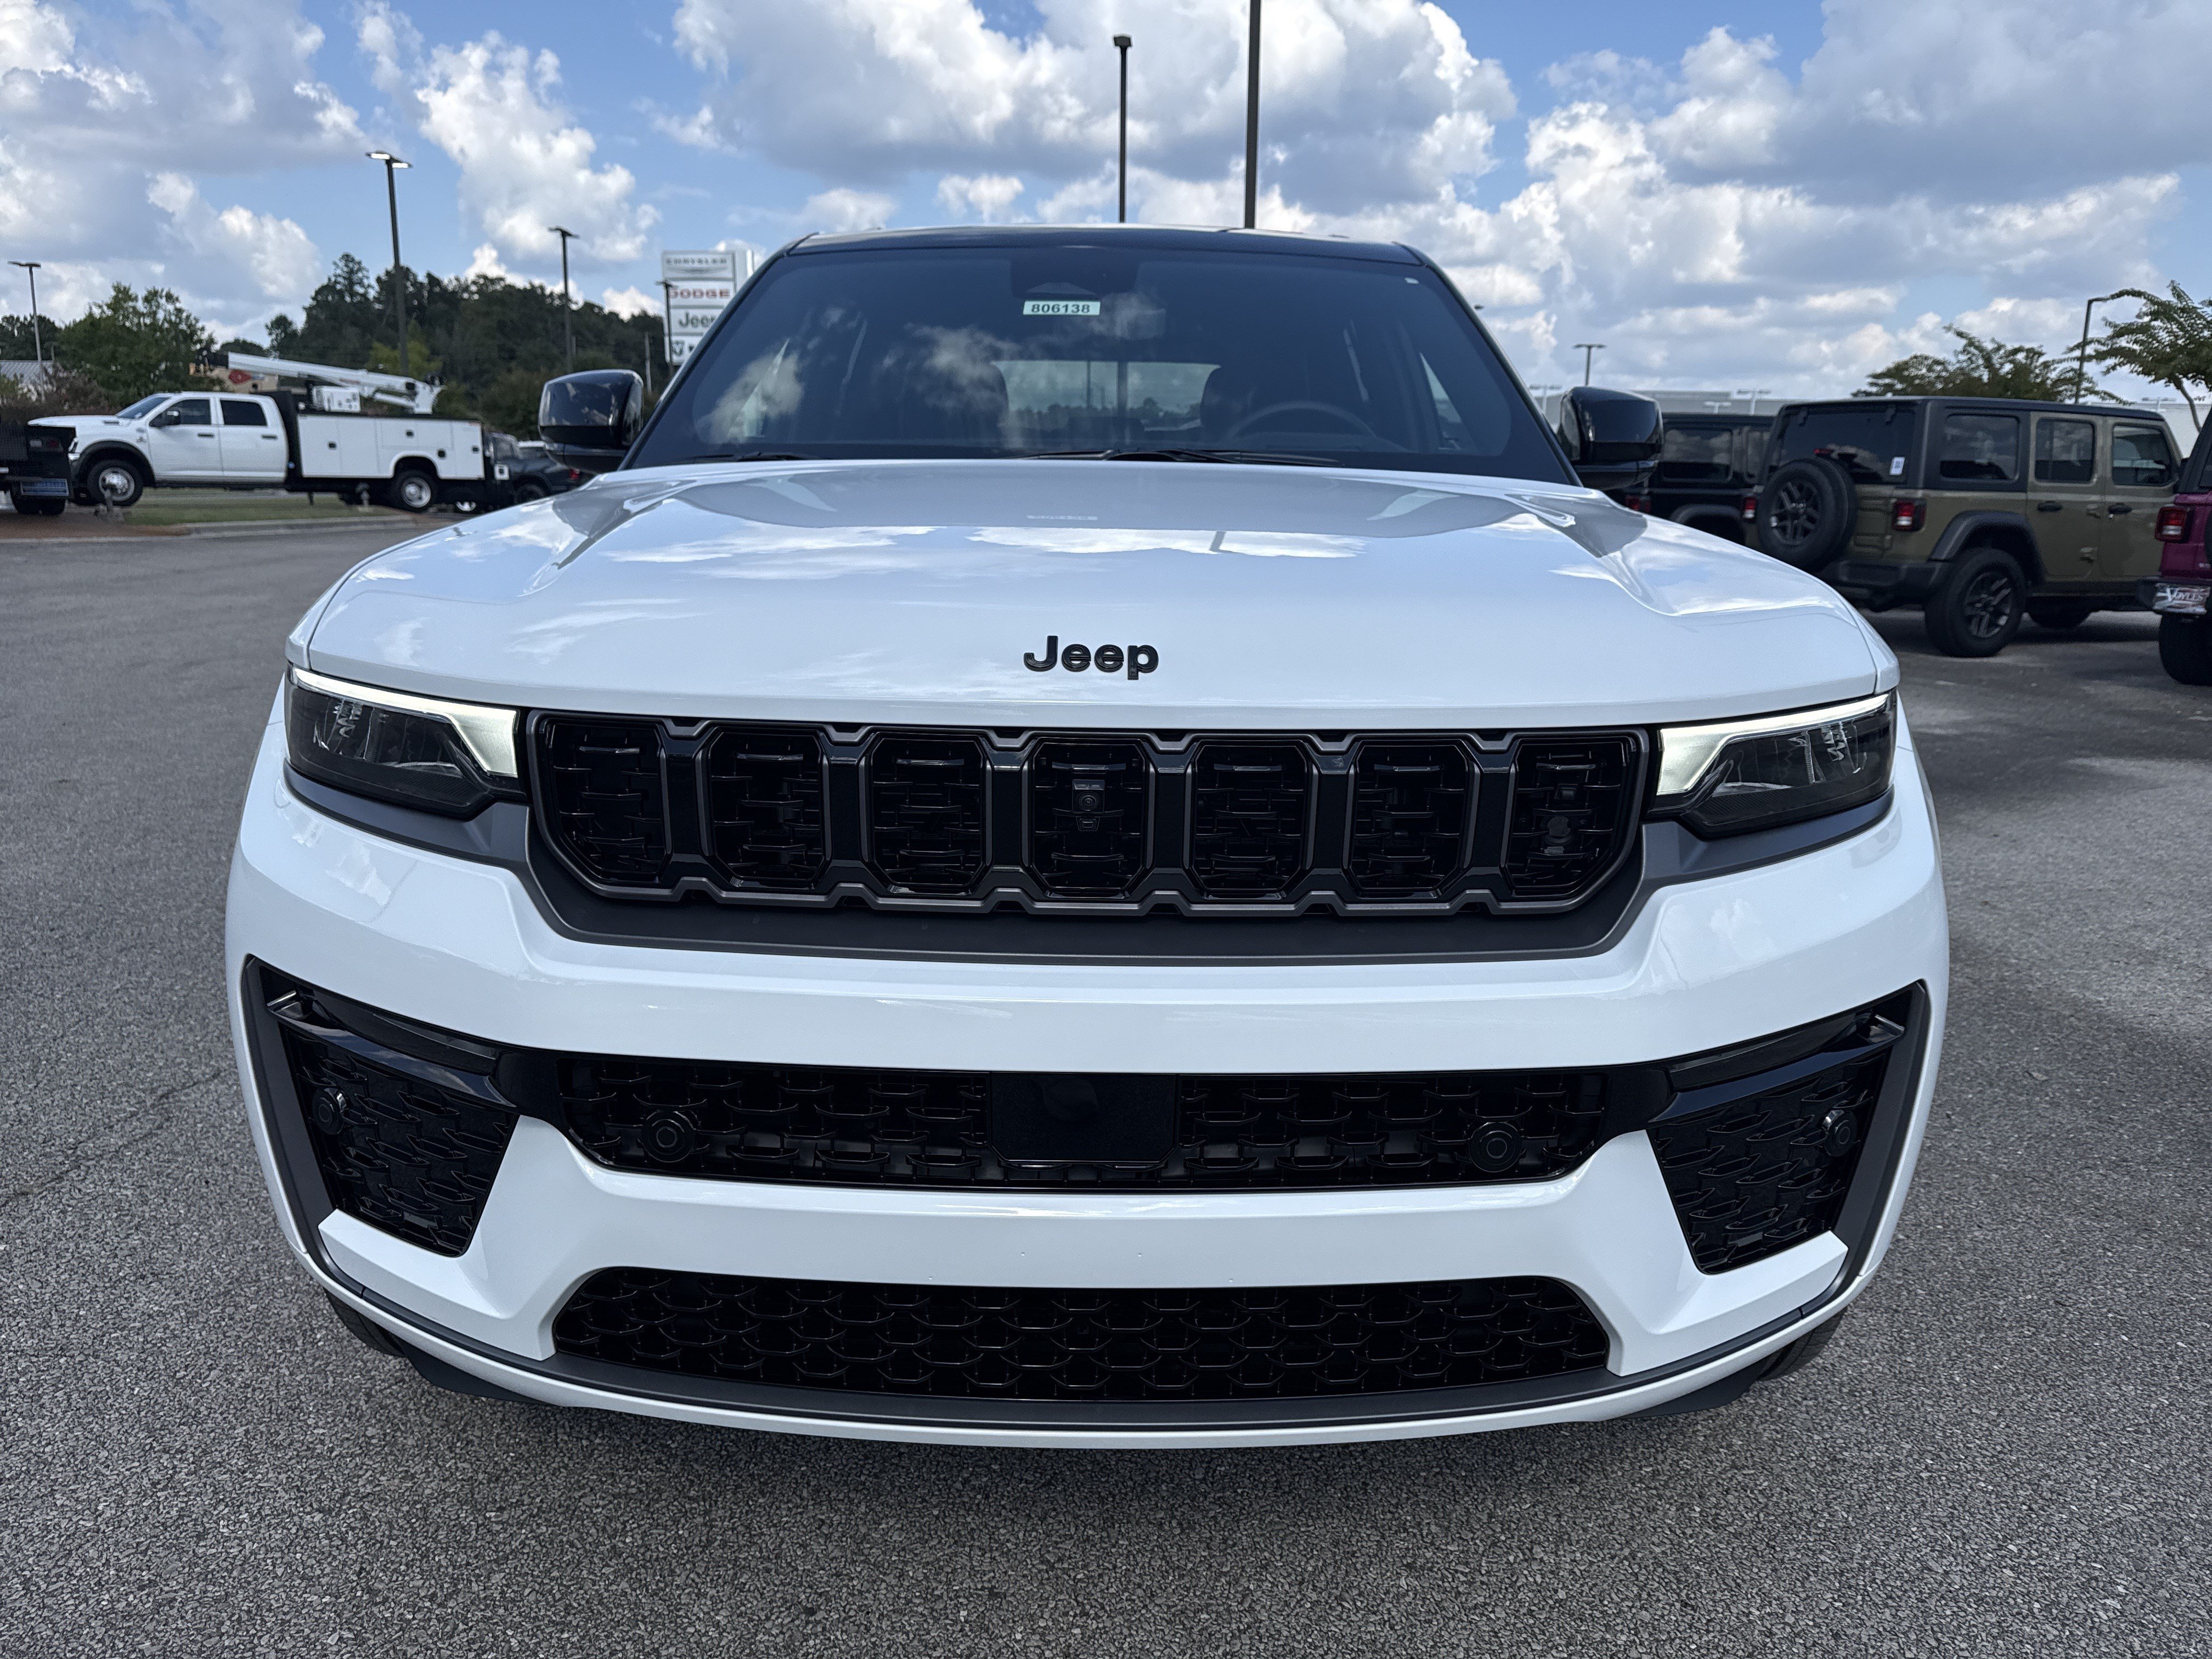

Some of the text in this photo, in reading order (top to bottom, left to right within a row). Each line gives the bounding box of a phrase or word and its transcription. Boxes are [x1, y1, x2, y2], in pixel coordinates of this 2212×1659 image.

[669, 288, 730, 299] DODGE
[1031, 303, 1091, 313] 806138
[1023, 635, 1159, 680] Jeep
